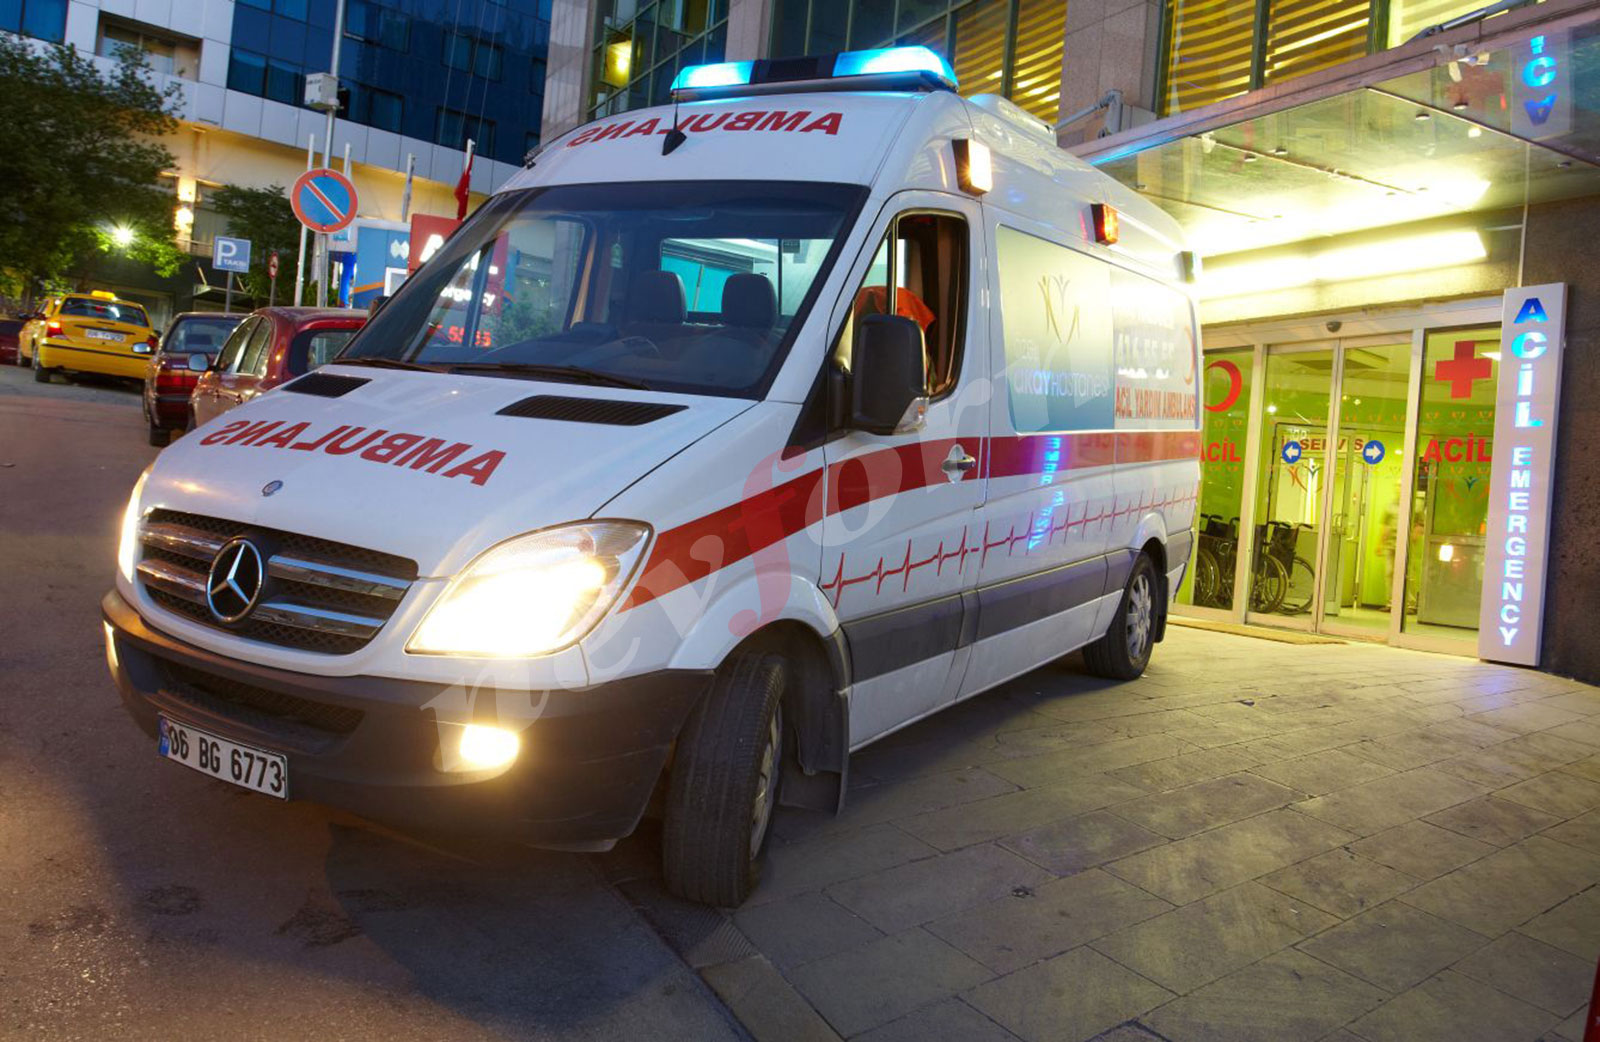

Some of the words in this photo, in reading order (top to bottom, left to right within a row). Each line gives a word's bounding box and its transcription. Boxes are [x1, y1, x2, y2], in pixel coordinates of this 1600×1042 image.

[217, 240, 236, 266] P
[1511, 298, 1549, 428] ACİL
[1422, 431, 1492, 462] ACİL
[1499, 447, 1532, 646] EMERGENCY
[168, 725, 189, 760] 06
[199, 736, 220, 773] BG
[231, 748, 283, 793] 6773
